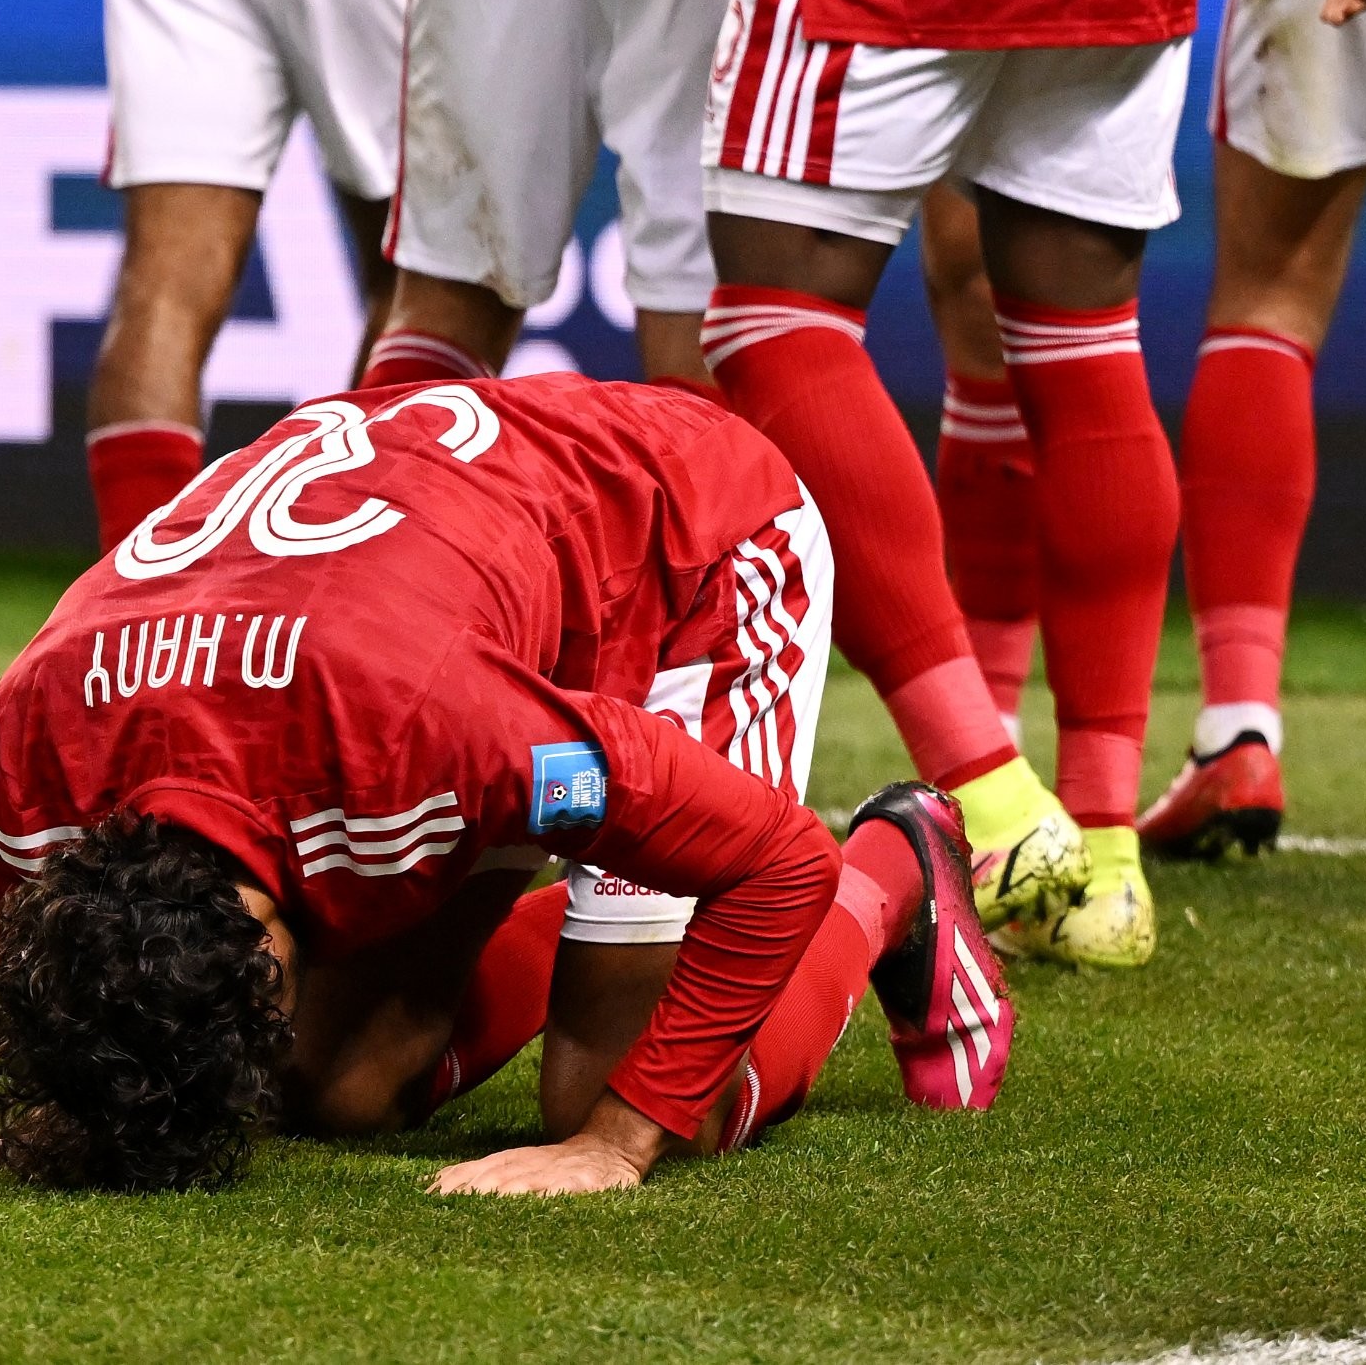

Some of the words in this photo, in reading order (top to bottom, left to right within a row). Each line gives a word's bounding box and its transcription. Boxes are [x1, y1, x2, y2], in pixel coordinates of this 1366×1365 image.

[115, 384, 501, 580] 30
[84, 613, 308, 708] M.HANY
[571, 772, 580, 809] FOOTBALL
[580, 771, 592, 808] UNITES
[590, 767, 602, 793] World
[592, 794, 601, 809] the
[594, 879, 663, 896] adida
